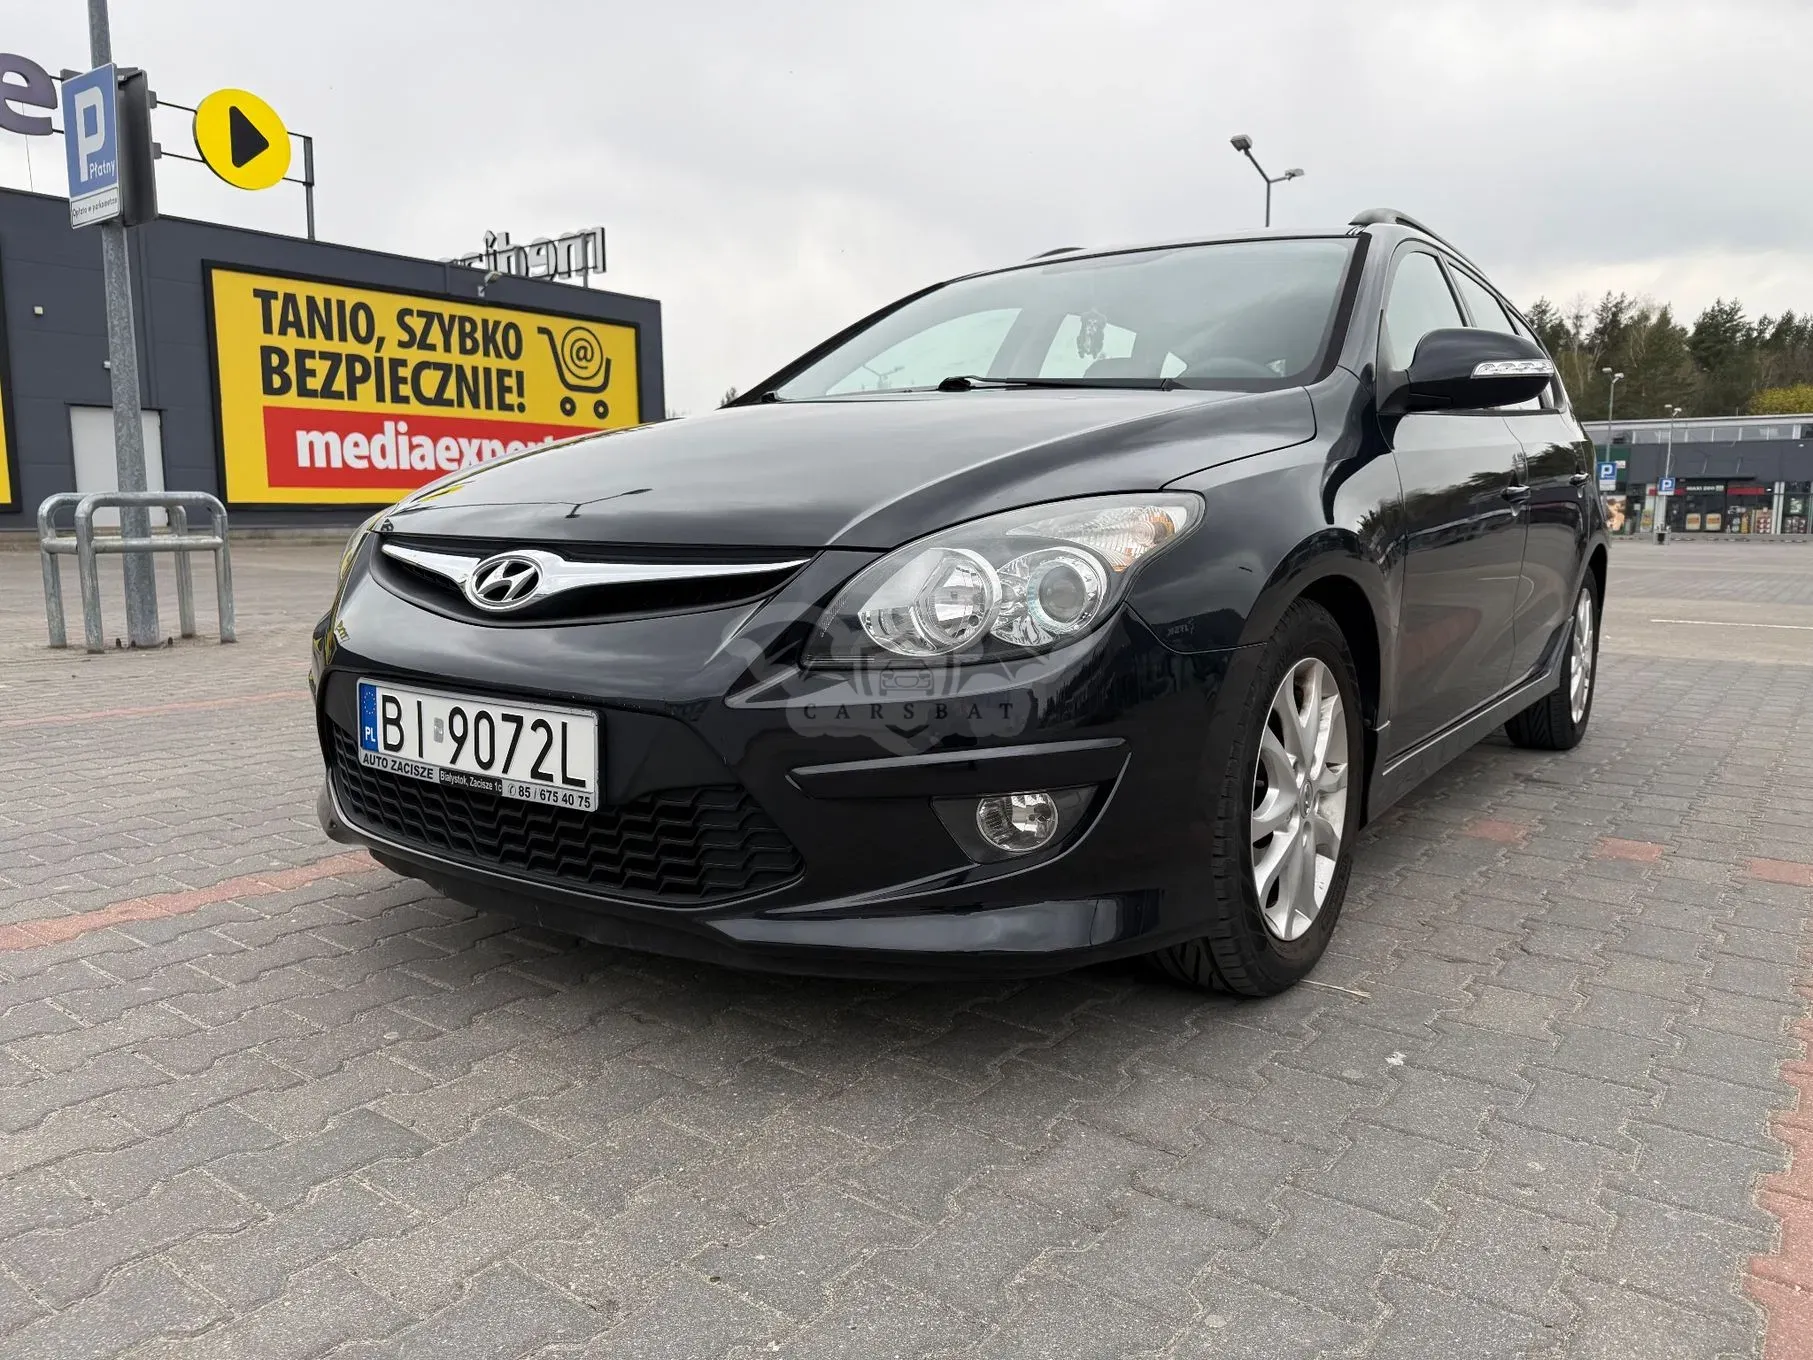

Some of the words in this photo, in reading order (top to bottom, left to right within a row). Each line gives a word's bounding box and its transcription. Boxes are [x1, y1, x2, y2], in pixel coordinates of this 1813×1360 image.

[74, 86, 105, 182] P
[89, 159, 116, 179] Płatny
[252, 287, 386, 354] TANIO,
[396, 307, 523, 361] SZYBKO
[260, 345, 526, 414] BEZPIECZNIE!
[296, 420, 554, 471] mediaexp
[365, 726, 376, 743] PL
[382, 694, 424, 759] BI
[448, 706, 586, 788] 9072L
[362, 752, 389, 769] AUTO
[390, 759, 434, 780] ZACISZE
[469, 776, 493, 791] Zacisze
[518, 785, 531, 799] 85
[539, 788, 559, 803] 675
[561, 792, 575, 806] 40
[577, 795, 591, 809] 75
